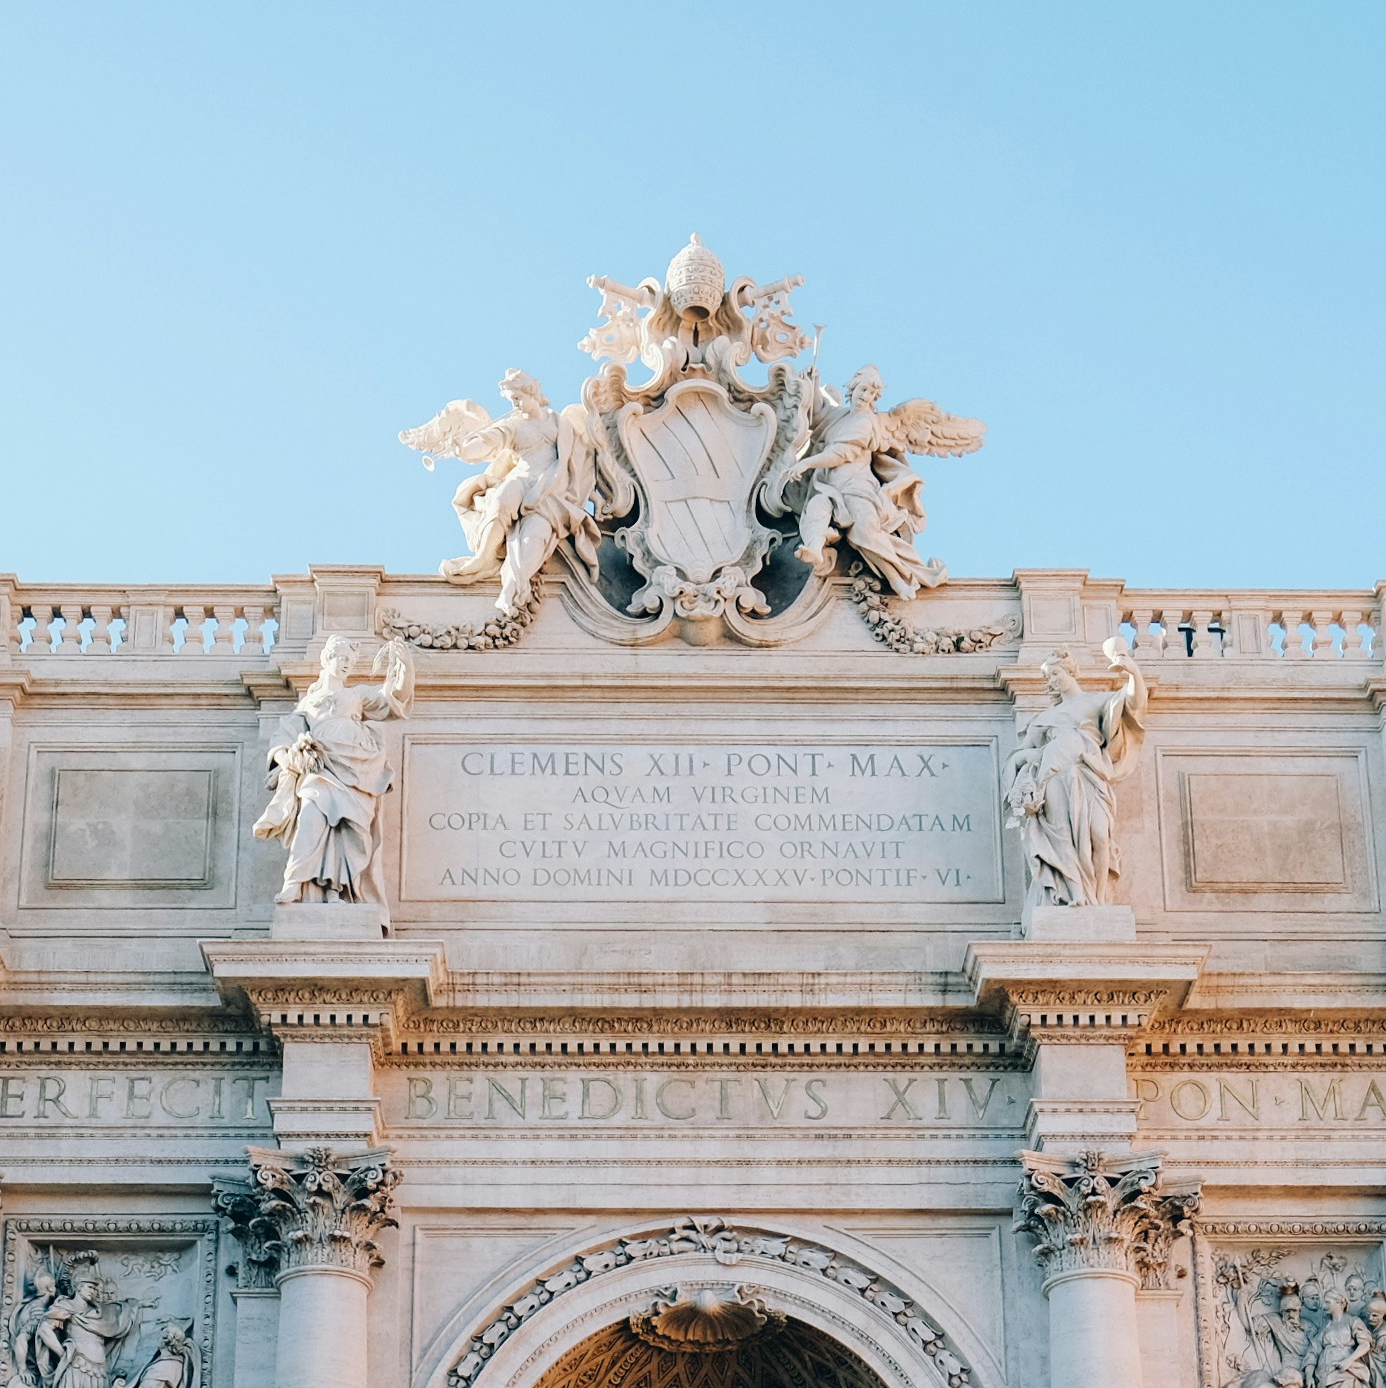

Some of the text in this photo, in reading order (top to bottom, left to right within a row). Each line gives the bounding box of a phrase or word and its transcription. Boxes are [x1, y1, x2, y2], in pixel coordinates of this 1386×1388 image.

[461, 752, 624, 776] CLEMENS
[571, 786, 832, 809] AQVAM VIRGINEM
[428, 812, 973, 832] COPIA ET SALVBRITATE COMMENDATAM
[499, 840, 905, 859] CVLTV MAGNIFICO ORNAVIT
[439, 867, 521, 887] ANNO
[532, 868, 634, 887] DOMINI
[404, 1076, 829, 1121] BENEDICTVS
